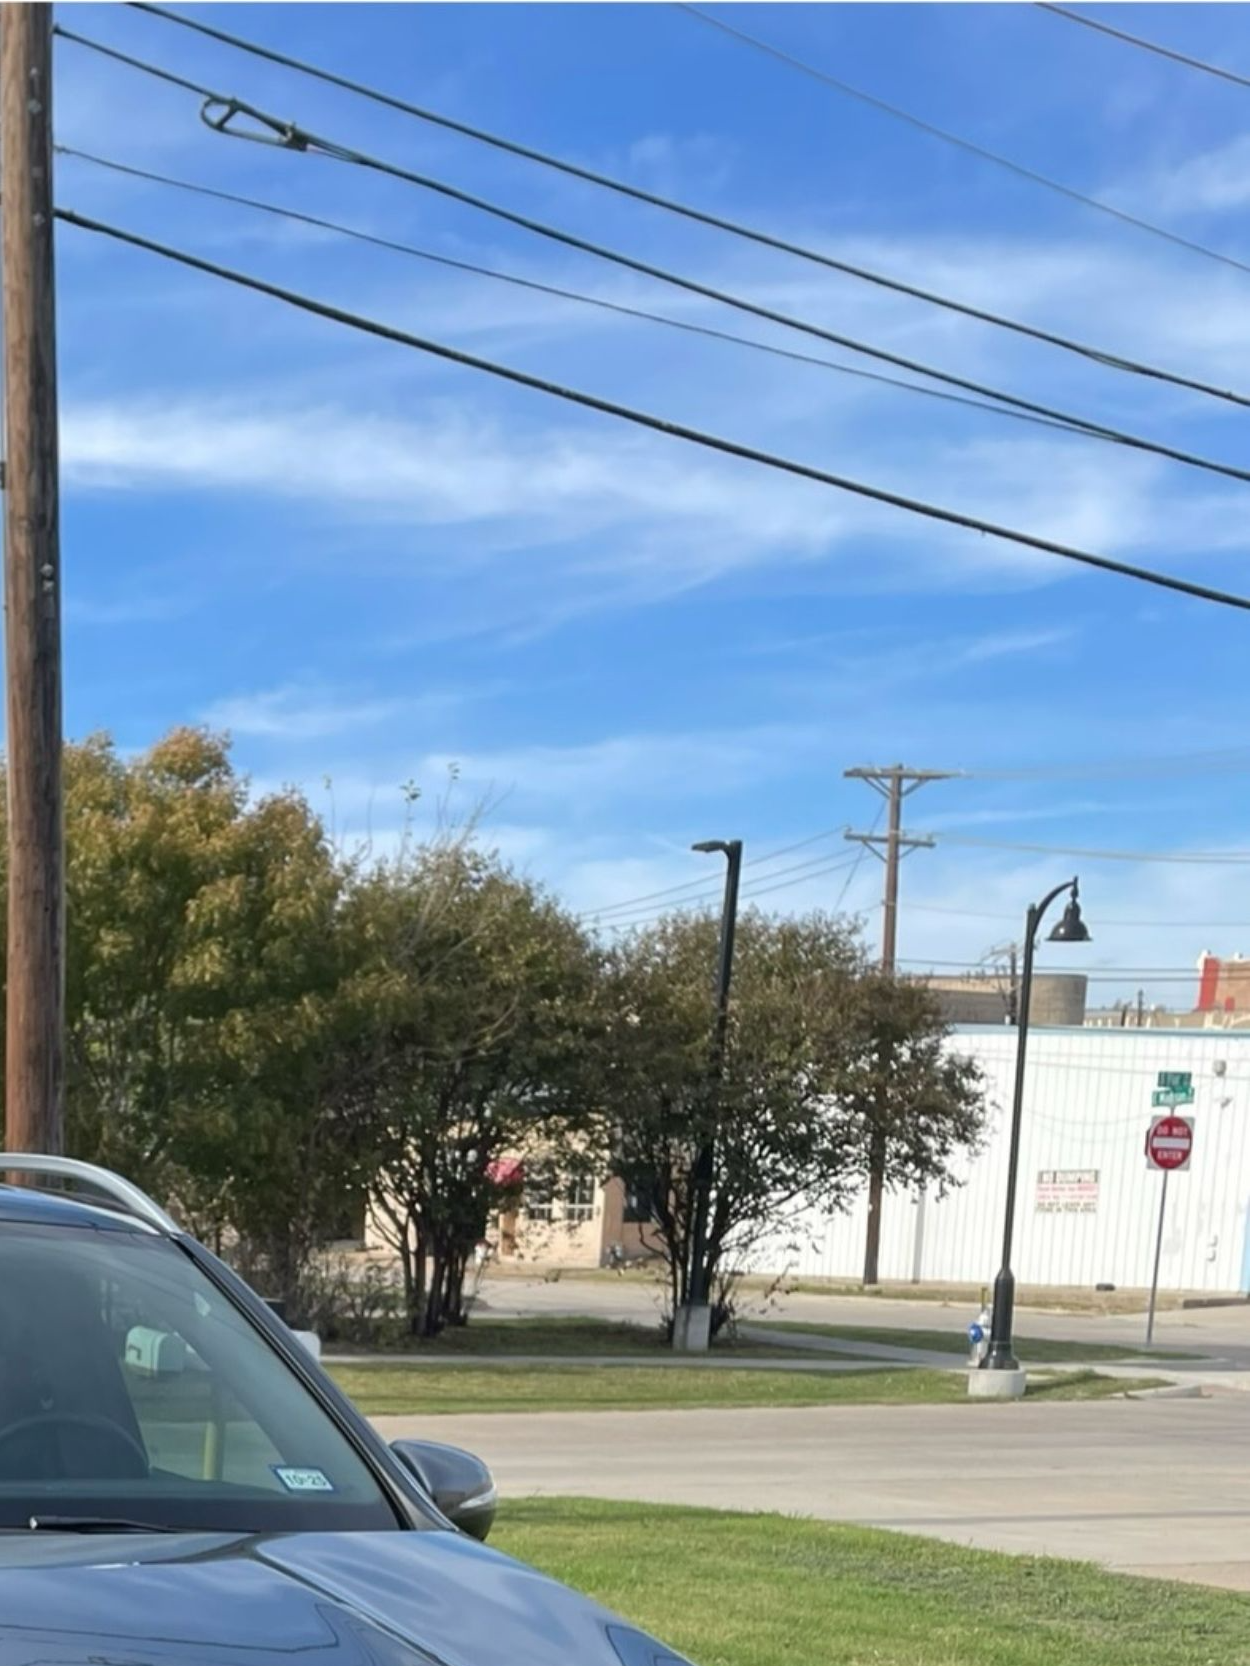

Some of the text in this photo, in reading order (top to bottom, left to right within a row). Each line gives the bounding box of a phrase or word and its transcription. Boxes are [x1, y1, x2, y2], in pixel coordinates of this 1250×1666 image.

[1156, 1125, 1188, 1136] DO NOT
[1157, 1150, 1182, 1161] ENTER
